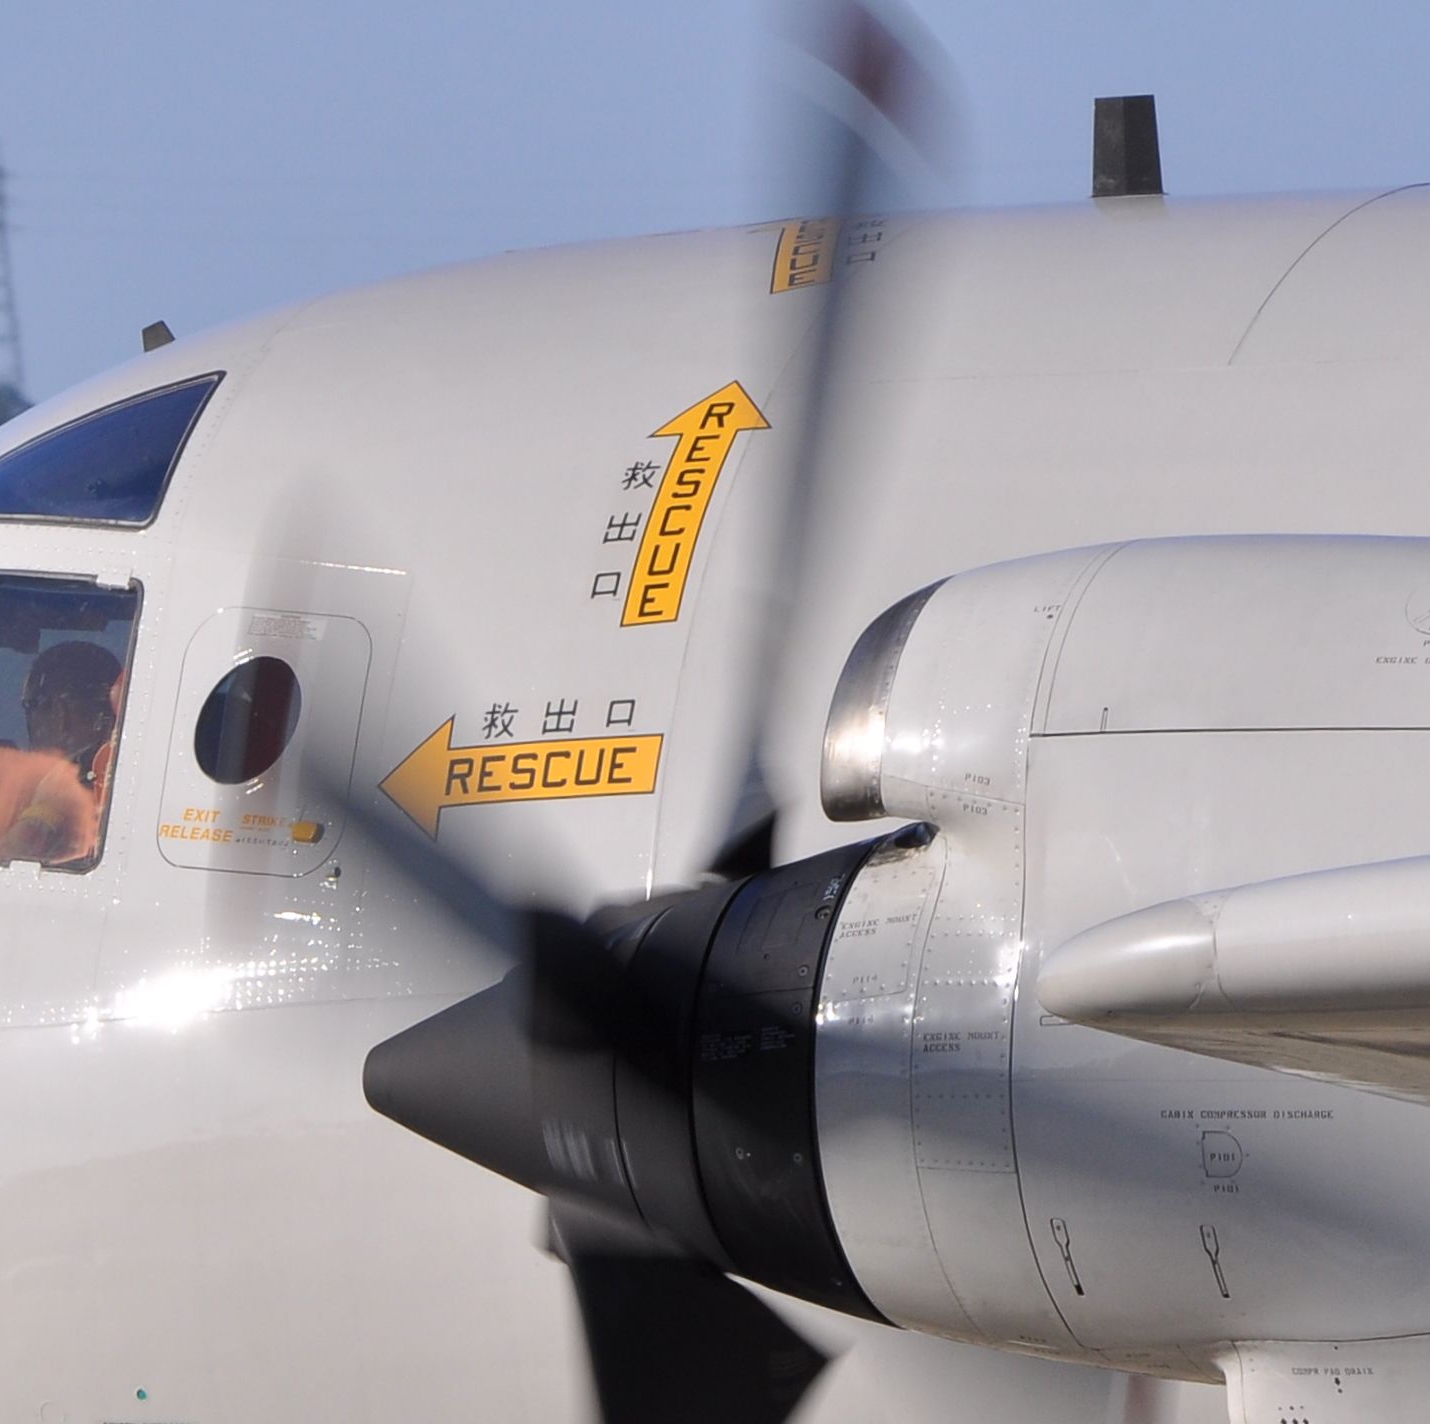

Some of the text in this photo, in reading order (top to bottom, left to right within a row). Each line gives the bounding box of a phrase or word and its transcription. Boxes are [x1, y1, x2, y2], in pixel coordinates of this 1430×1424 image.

[590, 460, 661, 599] 救出口
[638, 402, 736, 618] RESCUE
[482, 698, 636, 739] 救出口
[445, 746, 637, 796] RESCUE
[159, 824, 234, 842] RELEASE
[183, 808, 221, 823] EXIT
[1273, 1110, 1334, 1119] DISCHARGE
